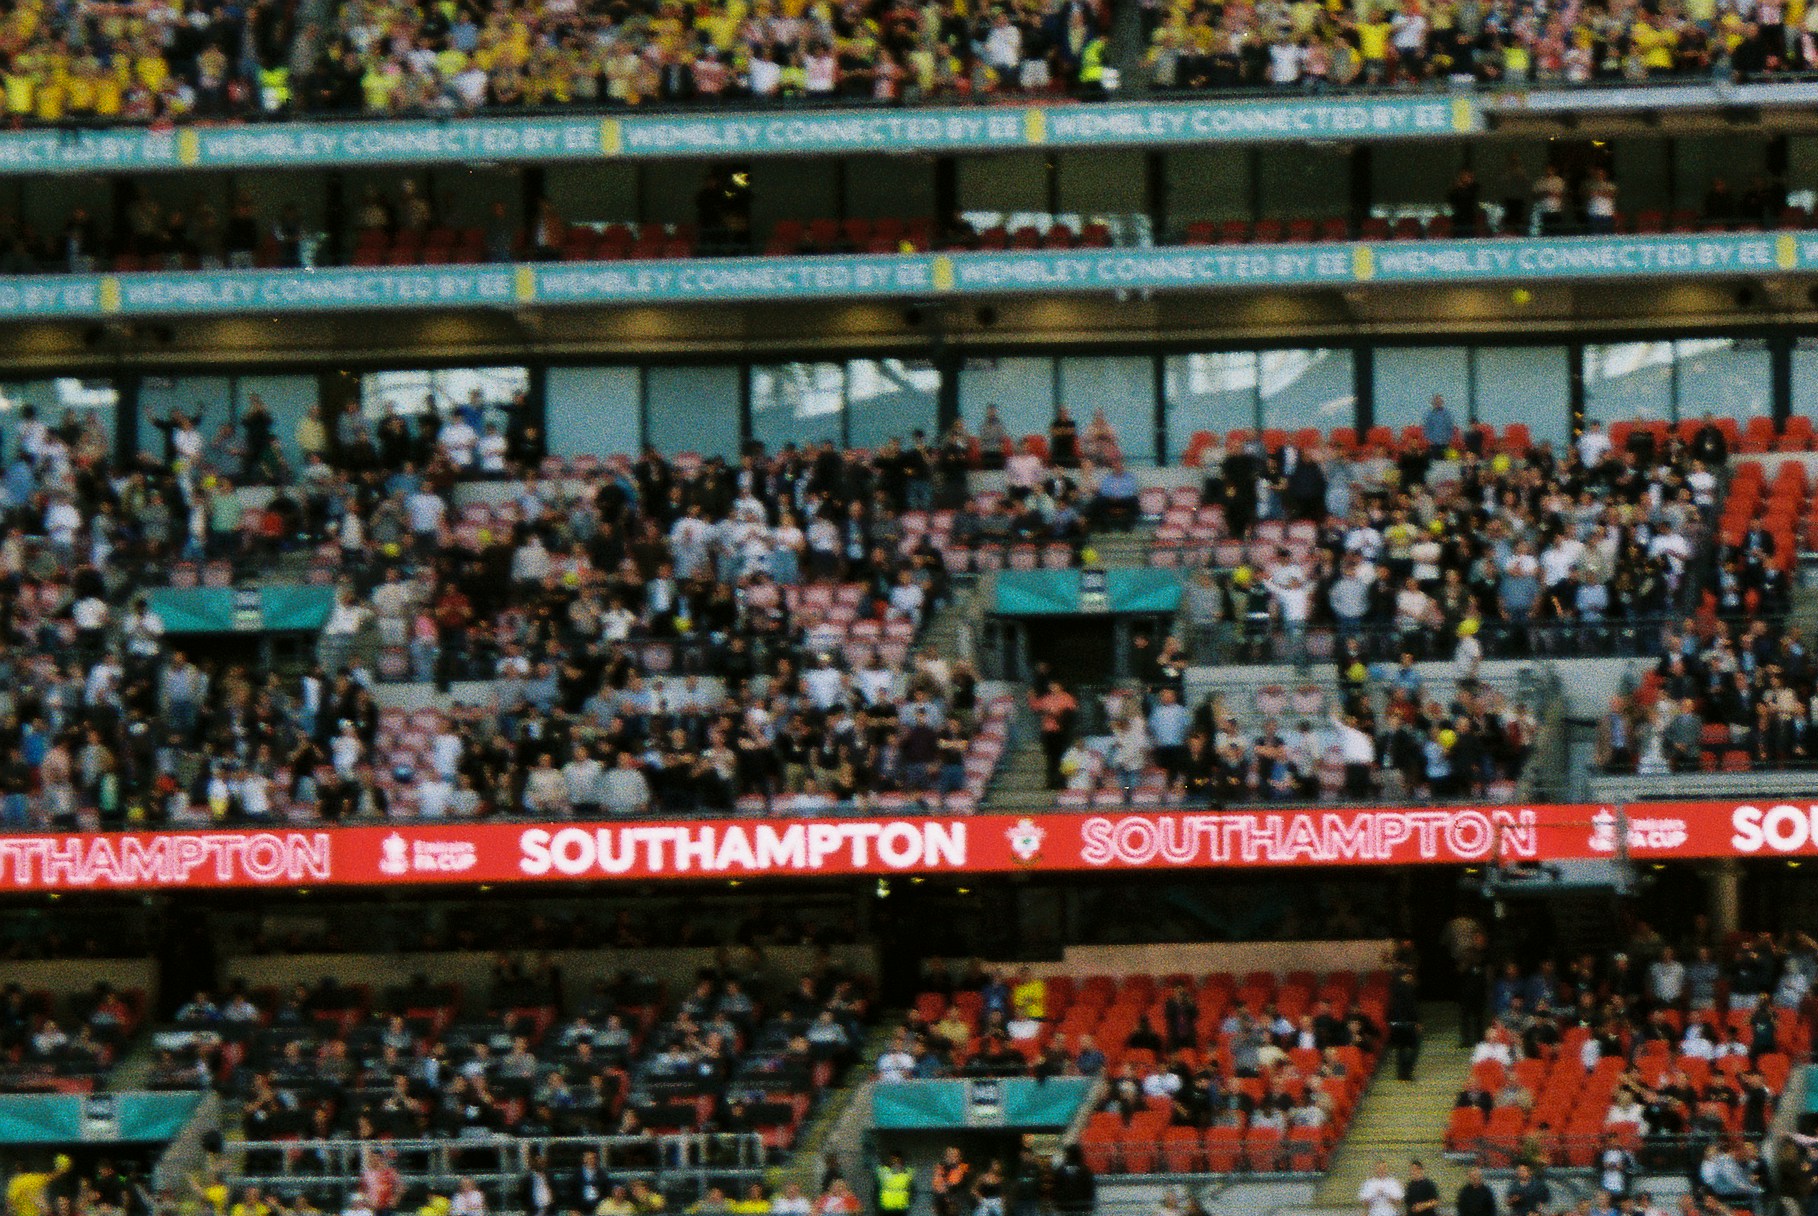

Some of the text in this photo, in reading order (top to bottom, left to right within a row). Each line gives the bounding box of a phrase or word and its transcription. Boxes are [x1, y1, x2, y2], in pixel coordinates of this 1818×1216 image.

[628, 114, 1018, 147] WEMBLEY CONNECTED BY EE
[1053, 103, 1447, 137] WEMBLEY CONNECTED BY EE
[208, 124, 595, 159] WEMBLEY CONNECTED BY EE
[962, 251, 1347, 283] WEMBLEY CONNECTED BY EE
[1382, 240, 1772, 273] WEMBLEY CONNECTED BY EE
[128, 272, 510, 305] WEMBLEY CONNECTED BY EE
[544, 261, 927, 294] WEMBLEY CONNECTED BY EE
[519, 822, 967, 874] SOUTHAMPTON
[1080, 810, 1538, 866] SOUTHAMPTON
[2, 833, 331, 886] THAMPTON
